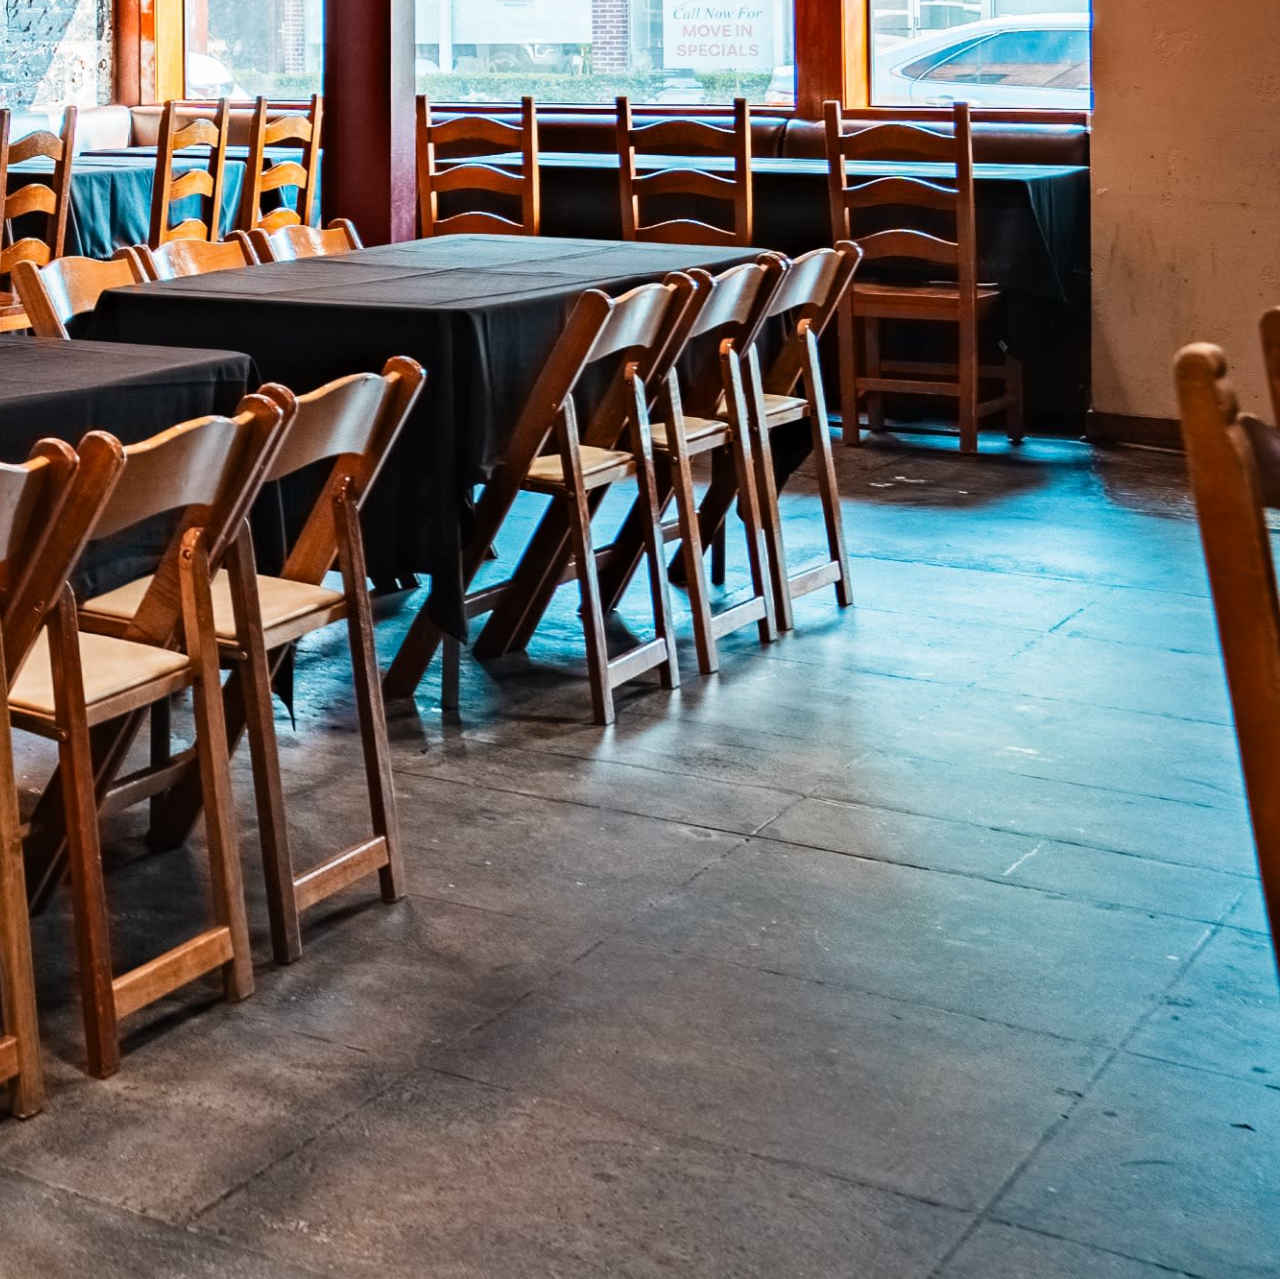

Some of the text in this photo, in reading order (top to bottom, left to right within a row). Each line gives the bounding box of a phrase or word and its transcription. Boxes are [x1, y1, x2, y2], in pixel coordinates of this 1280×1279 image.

[672, 6, 763, 20] Call Now For
[682, 24, 753, 38] MOVE IN
[676, 43, 760, 57] SPECIALS
